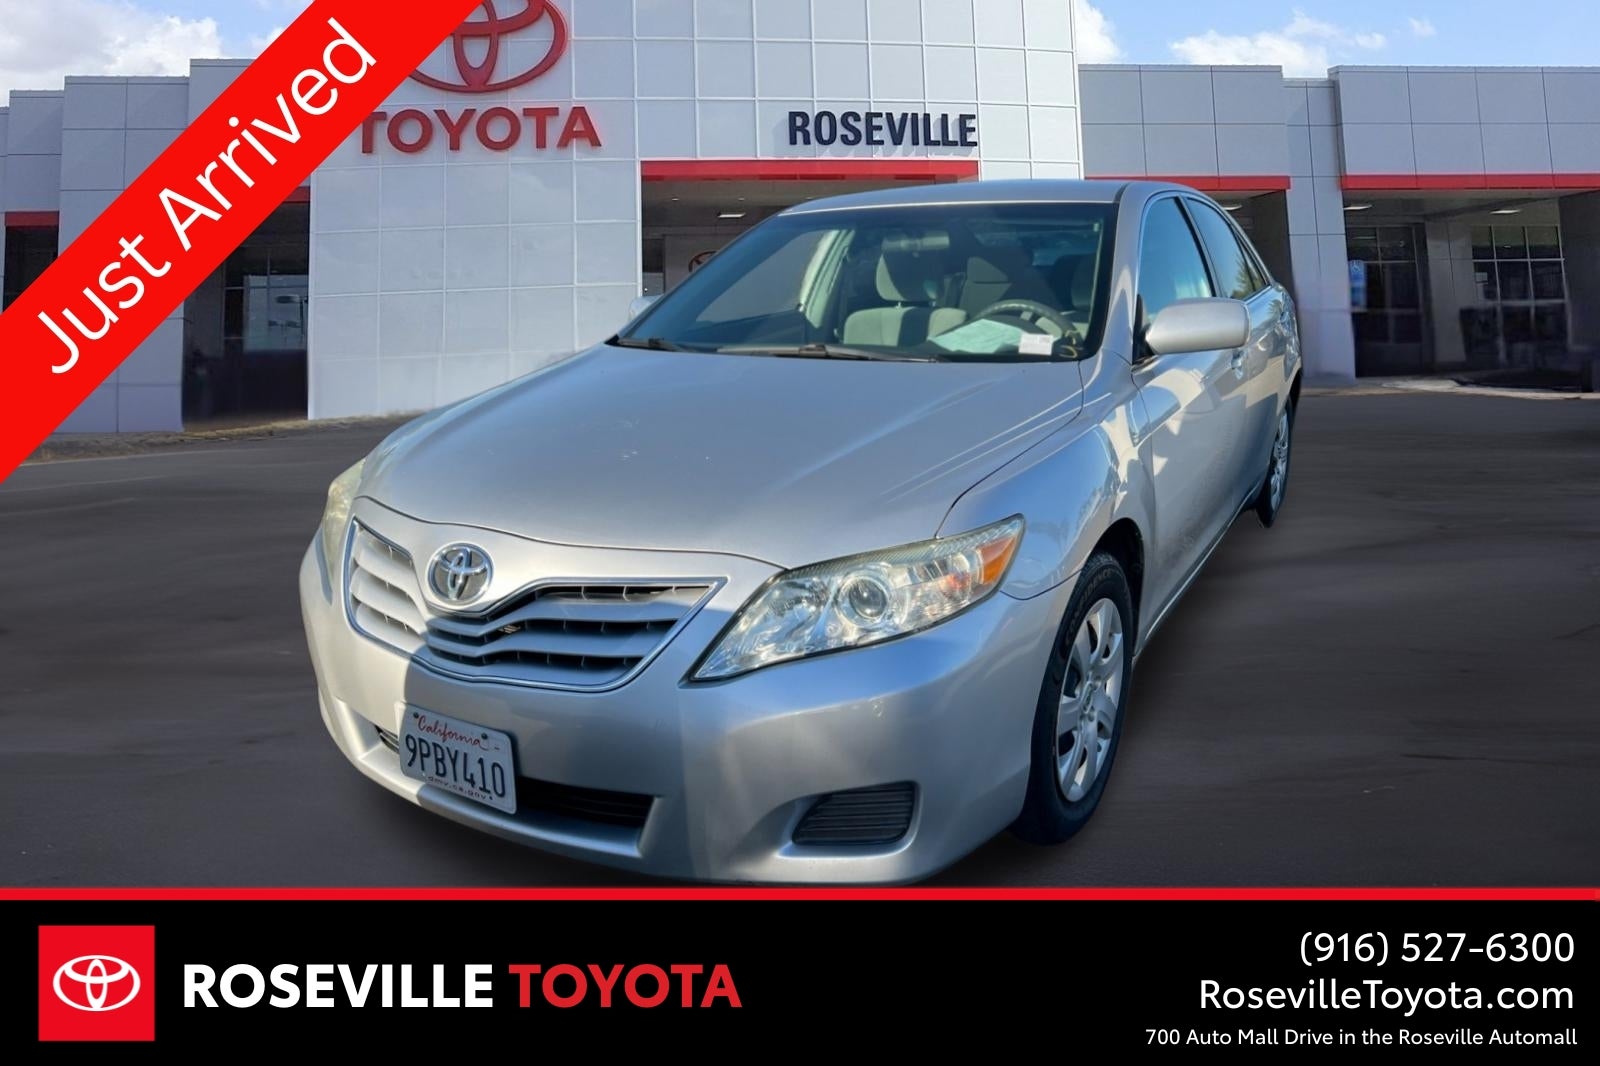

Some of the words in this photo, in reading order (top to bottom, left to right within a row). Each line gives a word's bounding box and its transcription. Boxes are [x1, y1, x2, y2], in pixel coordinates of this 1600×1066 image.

[361, 107, 602, 154] TOYOTA
[788, 111, 978, 147] ROSEVILLE
[418, 714, 489, 751] California
[405, 734, 506, 798] 9PBY410
